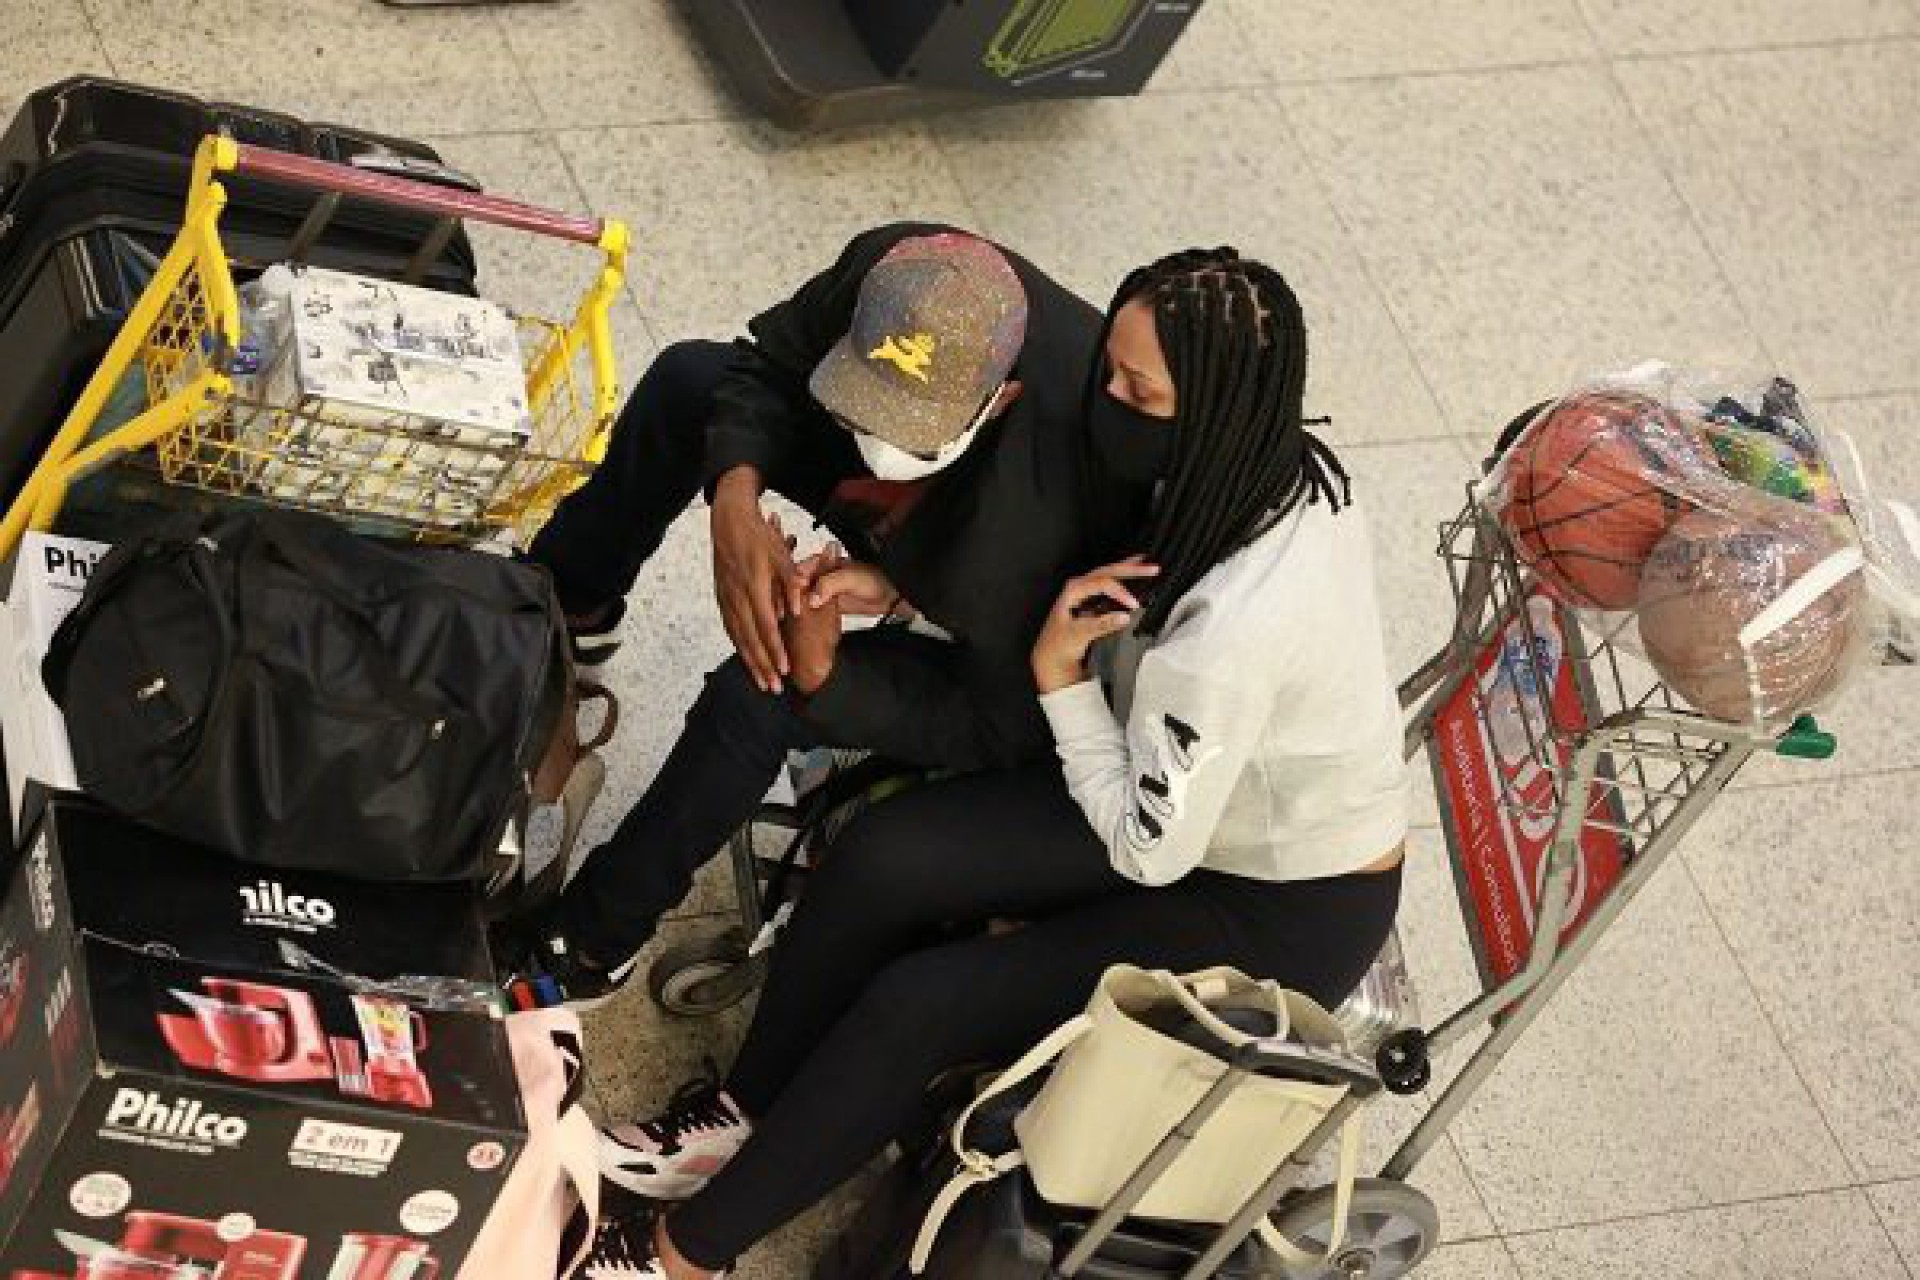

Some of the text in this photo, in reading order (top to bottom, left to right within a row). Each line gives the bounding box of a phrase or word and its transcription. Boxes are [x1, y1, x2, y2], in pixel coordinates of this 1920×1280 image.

[45, 546, 98, 577] Phi
[104, 1087, 248, 1143] Philco
[306, 1125, 392, 1155] 2 em 1
